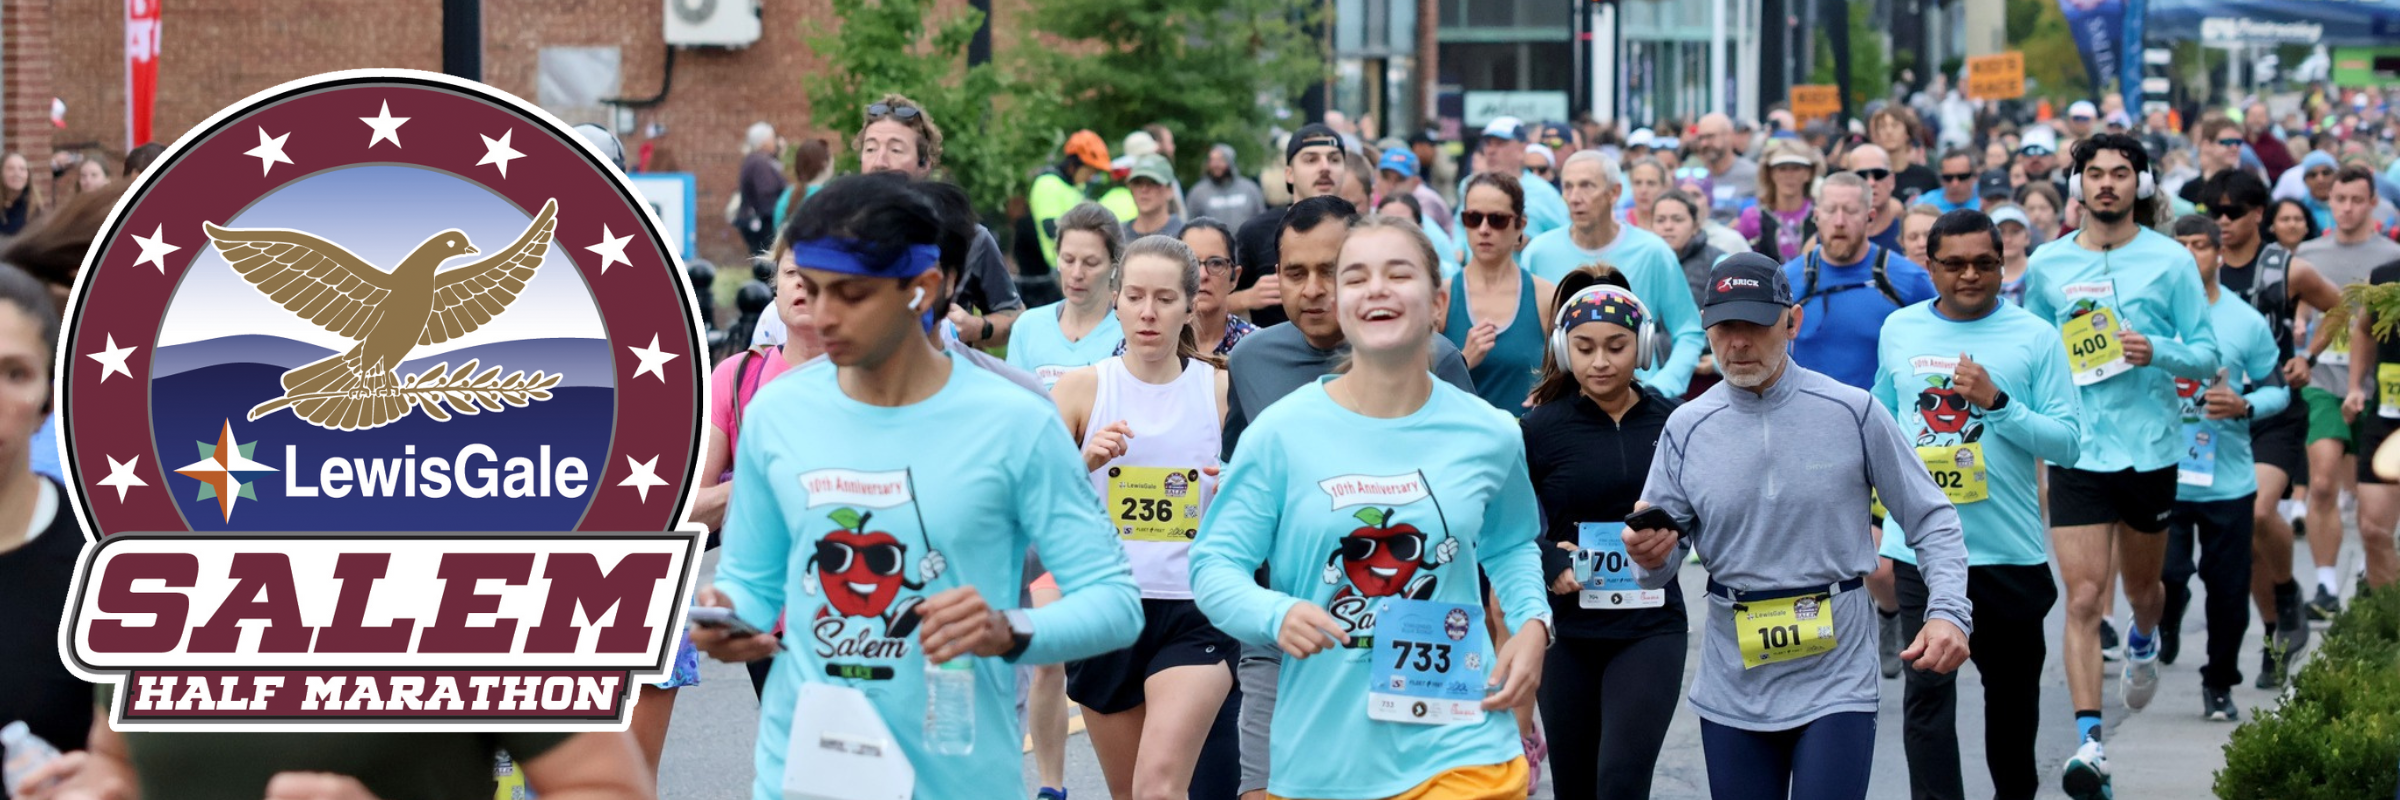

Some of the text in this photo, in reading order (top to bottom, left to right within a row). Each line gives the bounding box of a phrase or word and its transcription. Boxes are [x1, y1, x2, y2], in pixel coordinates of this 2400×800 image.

[1732, 278, 1759, 287] BRICK
[2072, 333, 2108, 357] 400
[809, 476, 902, 495] 10th Anniversary
[1331, 479, 1419, 498] 10th Anniversary
[1930, 470, 1963, 488] 02
[1121, 497, 1173, 522] 236
[1755, 610, 1786, 619] LewisGale
[814, 618, 907, 658] Salem
[1758, 624, 1801, 650] 101
[1392, 640, 1451, 673] 733
